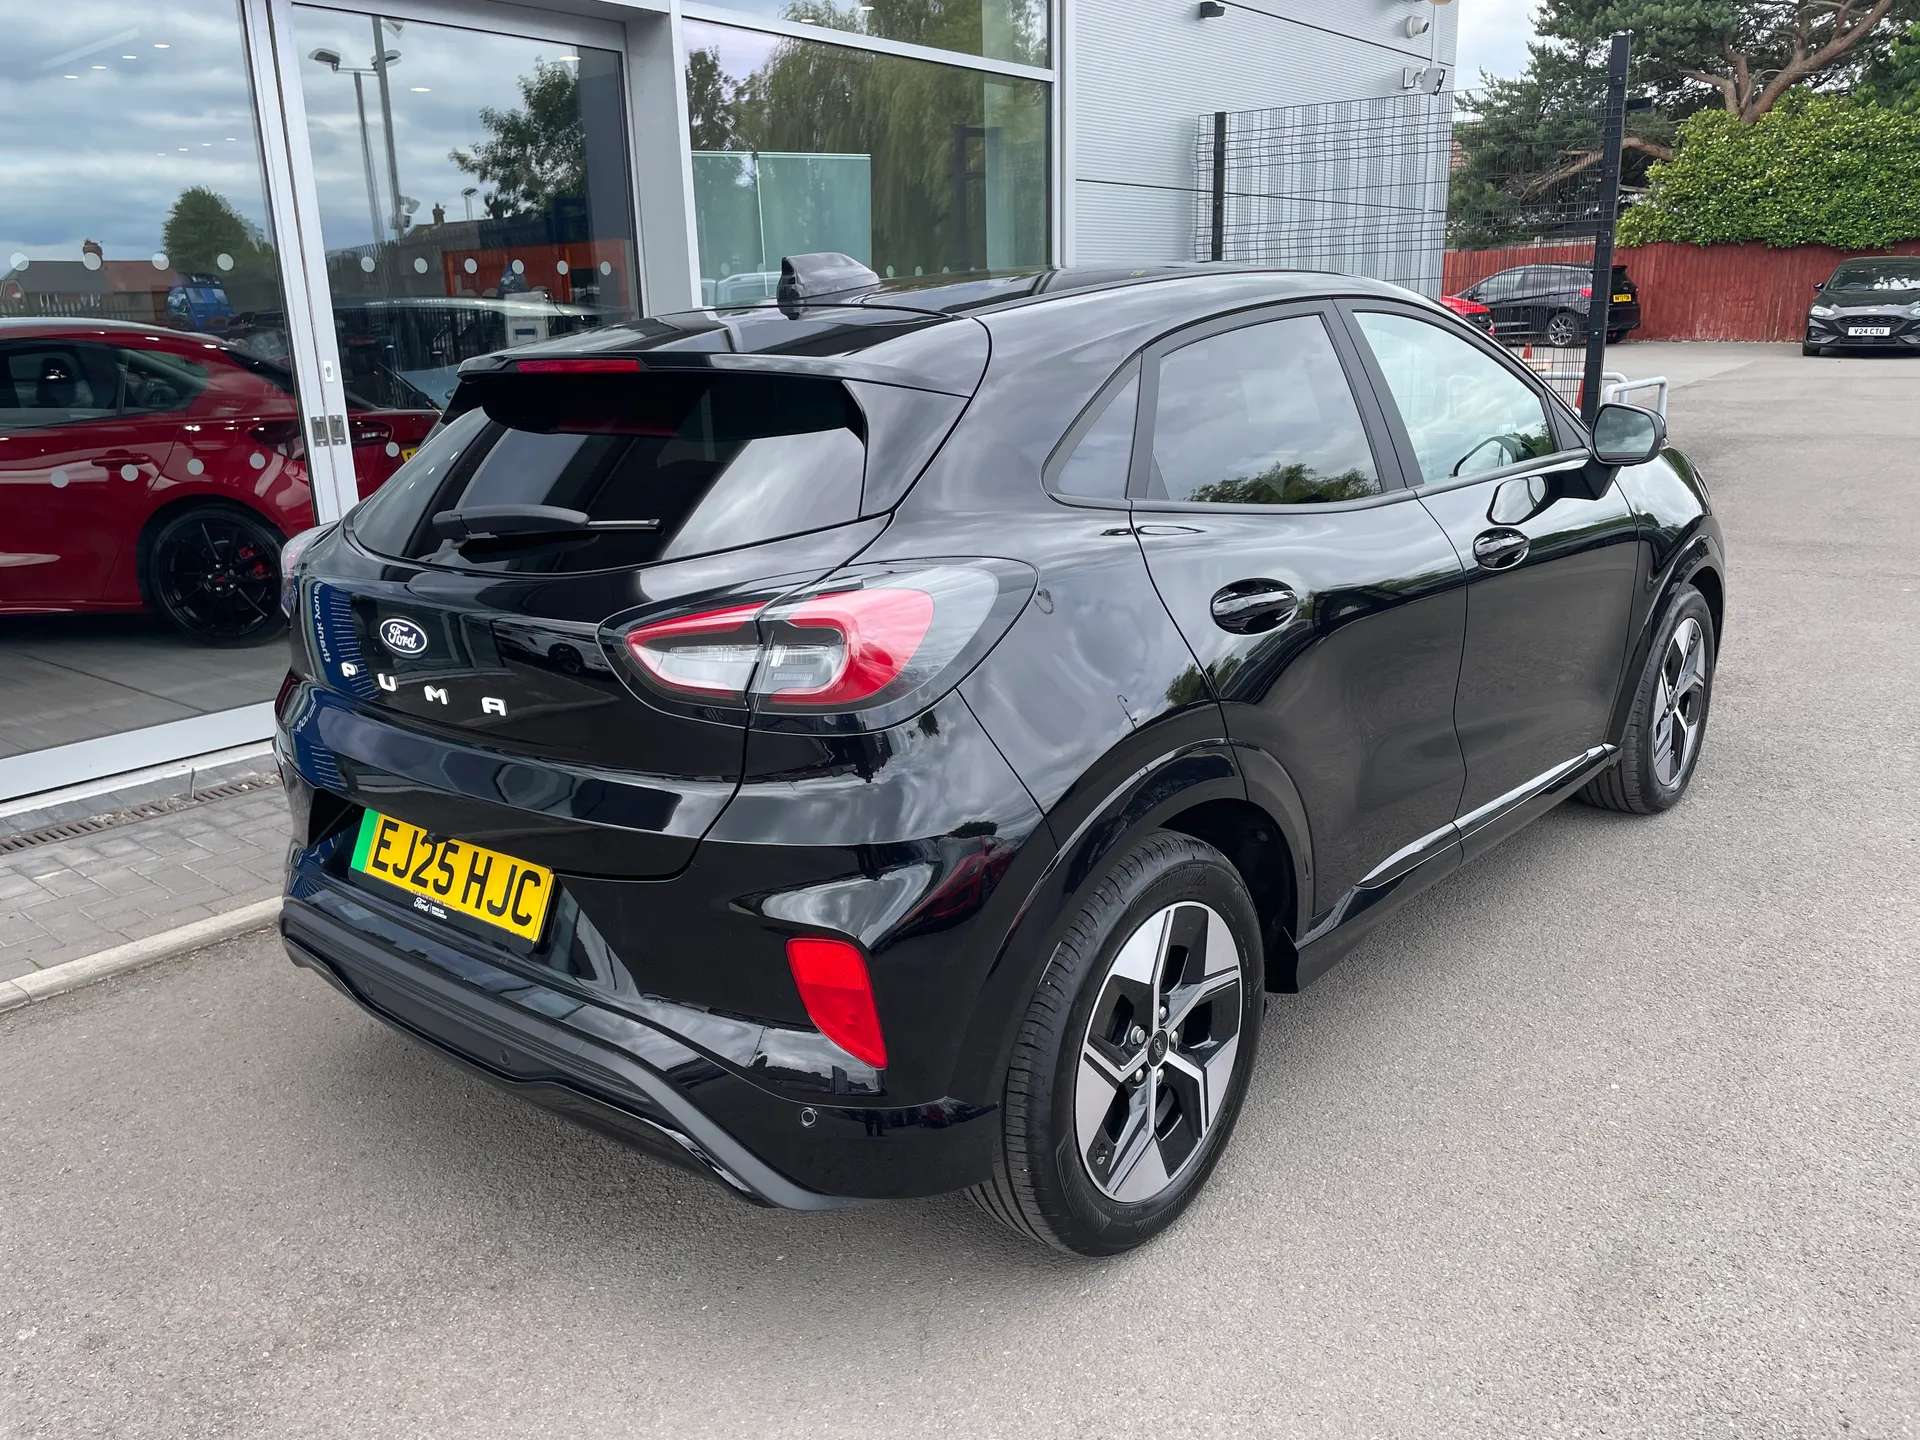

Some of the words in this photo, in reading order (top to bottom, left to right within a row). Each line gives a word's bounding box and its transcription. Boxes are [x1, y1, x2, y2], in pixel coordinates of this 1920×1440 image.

[387, 624, 418, 650] Ford
[342, 662, 509, 716] PUMA
[372, 819, 459, 895] EJ25
[461, 851, 541, 926] HJC
[413, 896, 430, 912] Ford
